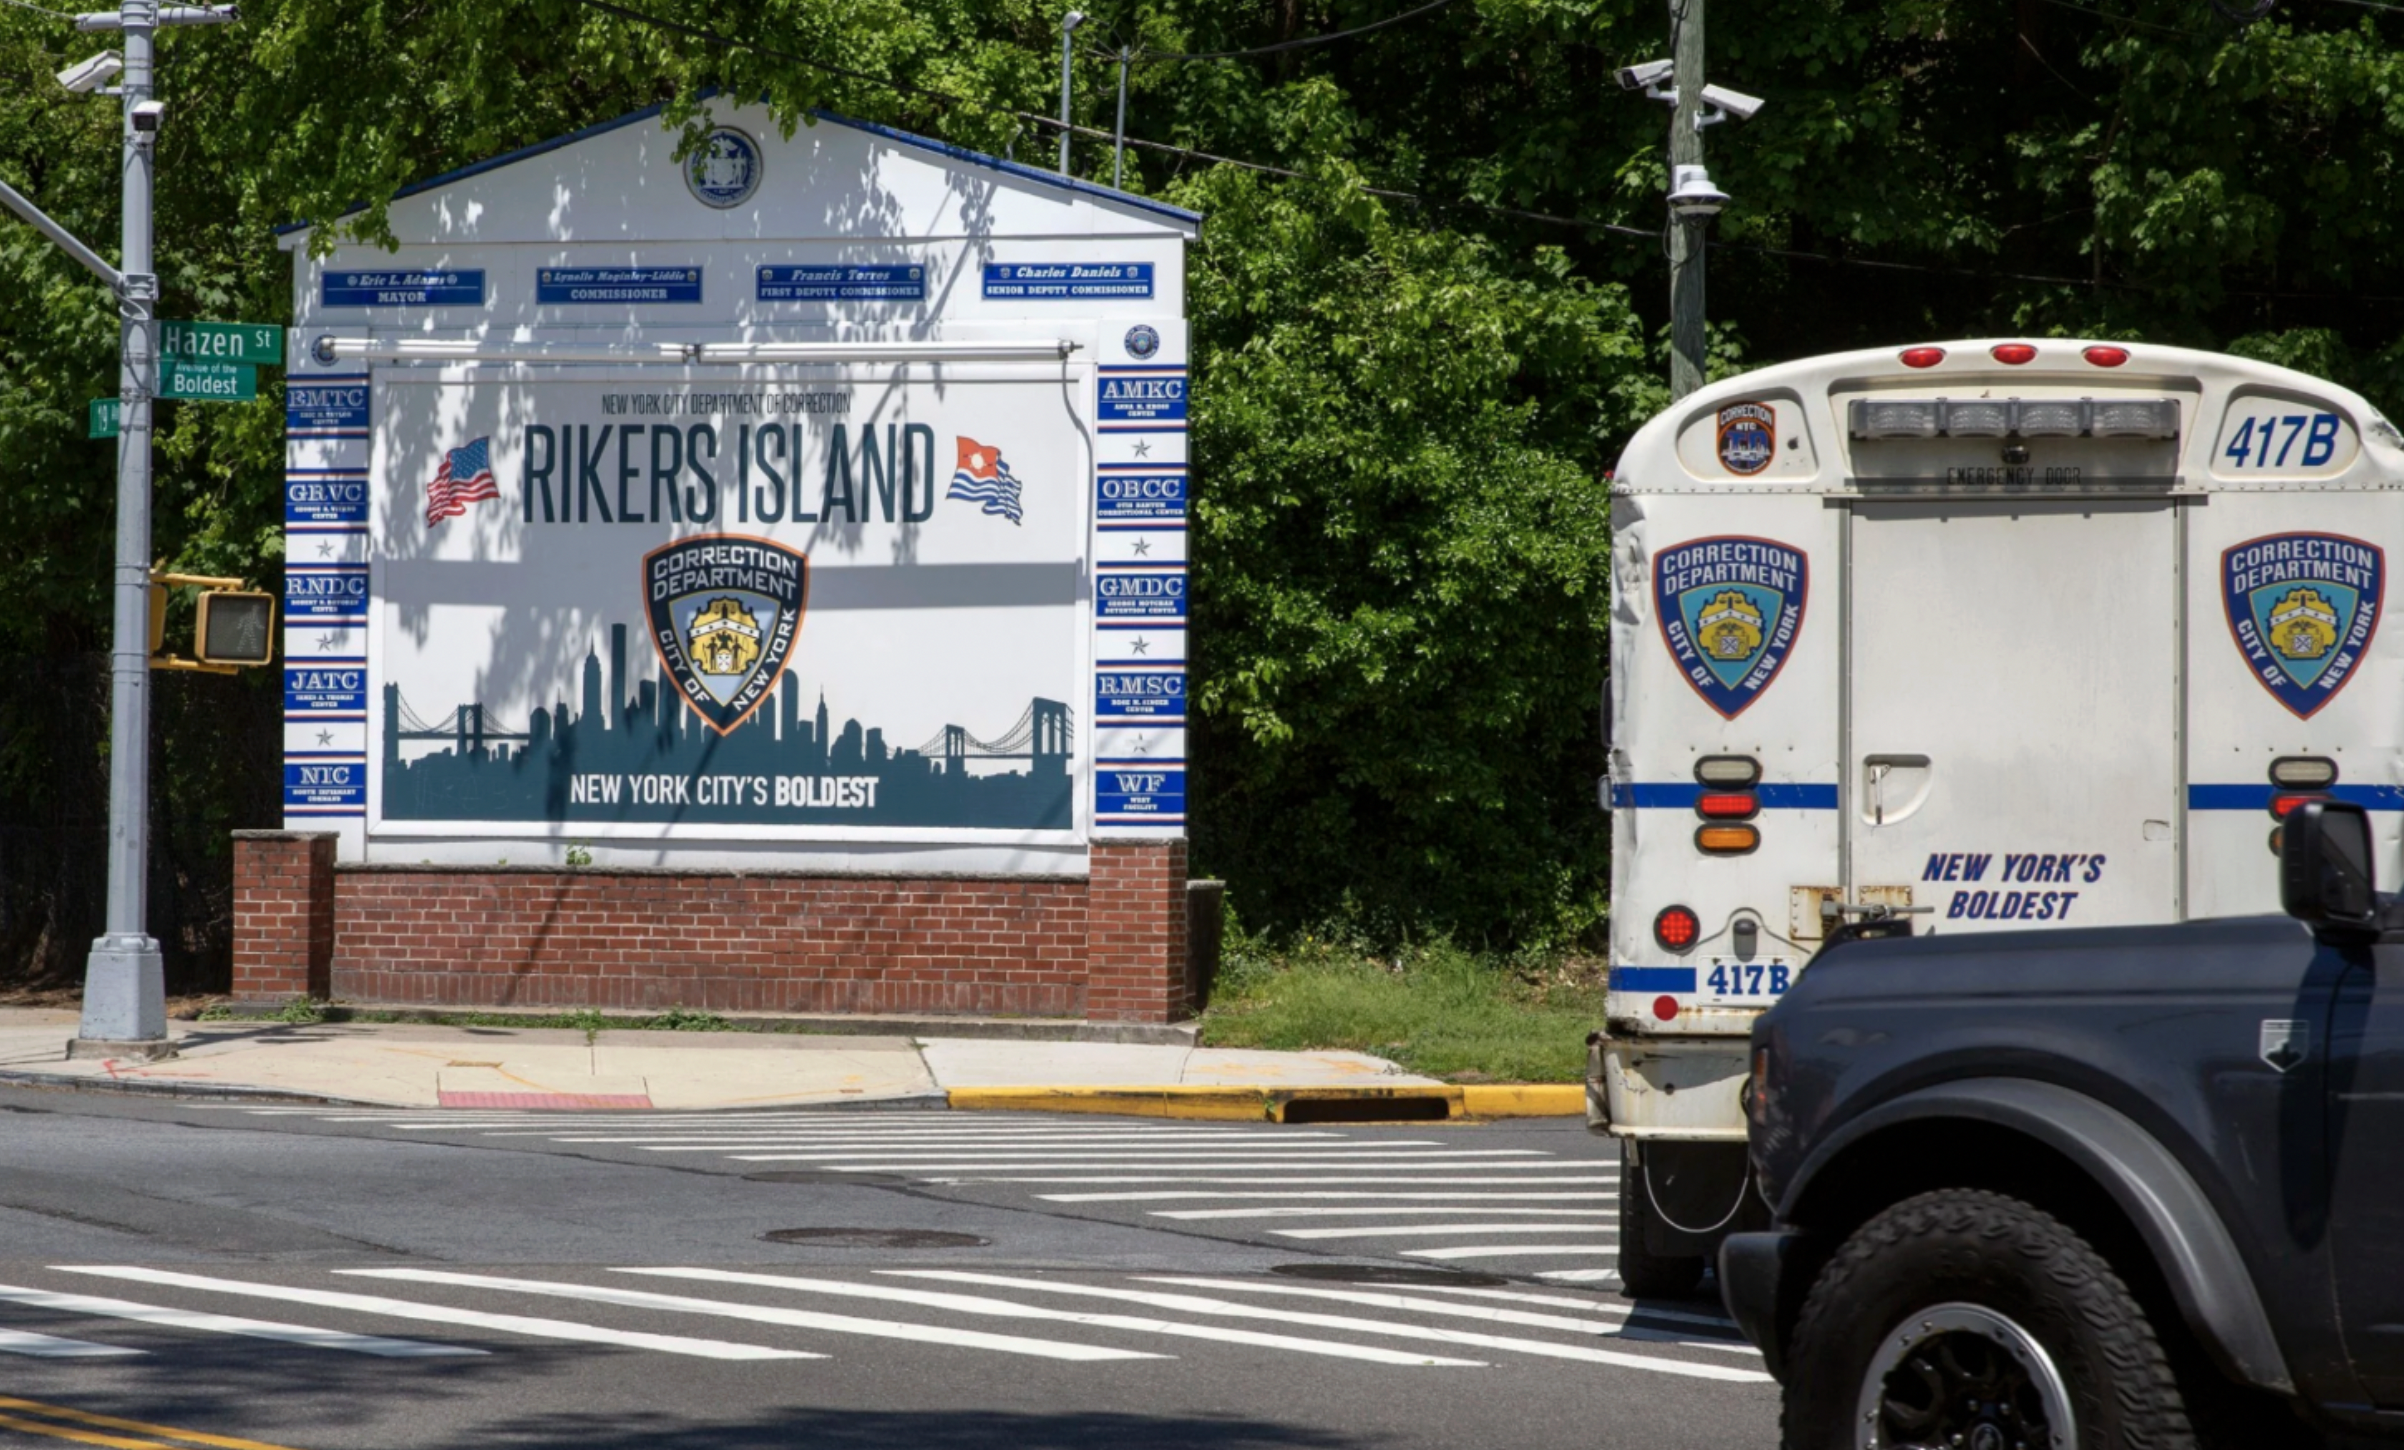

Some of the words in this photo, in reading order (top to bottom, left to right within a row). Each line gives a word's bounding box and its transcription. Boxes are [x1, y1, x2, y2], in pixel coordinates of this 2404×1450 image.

[359, 275, 386, 286] Eric
[388, 275, 400, 286] L.
[402, 274, 446, 286] Adams
[791, 269, 842, 281] Francis
[848, 269, 891, 281] Torres
[1016, 267, 1066, 278] Charles
[1070, 267, 1122, 278] Daniels
[378, 292, 426, 303] MAYOR
[570, 288, 668, 300] COMMISSIONER
[761, 287, 793, 297] FIRST
[795, 287, 837, 297] DEPUTY
[840, 286, 921, 296] COMMISSIONER
[986, 286, 1025, 295] SENIOR
[1028, 286, 1068, 295] DEPUTY
[1071, 285, 1149, 295] COMMISSIONER
[166, 326, 244, 357] Hazen
[255, 330, 272, 348] St
[211, 361, 220, 374] of
[222, 363, 237, 374] the
[174, 373, 238, 396] Boldest
[1102, 380, 1182, 399] AMKC
[288, 389, 364, 408] EMTC
[602, 393, 629, 415] NEW
[631, 393, 661, 415] YORK
[663, 393, 690, 415] CITY
[691, 392, 765, 415] DEPARTMENT
[766, 393, 782, 414] OF
[783, 392, 851, 414] CORRECTION
[1720, 404, 1772, 426] CORRECTION
[2225, 413, 2341, 468] 417B
[523, 422, 717, 524] RIKERS
[738, 422, 935, 524] ISLAND
[1947, 467, 2034, 485] EMERGENCY
[2045, 467, 2081, 485] DOOR
[288, 484, 362, 502] GRVC
[1102, 479, 1180, 498] OBCC
[654, 546, 797, 580] CORRECTION
[1663, 543, 1797, 575] CORRECTION
[2231, 539, 2373, 573] CORRECTION
[285, 577, 365, 595] RNDC
[653, 567, 796, 601] DEPARTMENT
[1099, 577, 1183, 597] GMDC
[1664, 563, 1796, 596] DEPARTMENT
[2234, 559, 2373, 595] DEPARTMENT
[1667, 620, 1696, 662] CITY
[1691, 665, 1715, 688] OF
[1743, 653, 1778, 691] NEW
[1772, 602, 1800, 649] YORK
[2237, 619, 2267, 661] CITY
[2263, 665, 2288, 688] OF
[2318, 652, 2354, 689] NEW
[2346, 600, 2376, 648] YORK
[659, 629, 688, 672] CITY
[684, 677, 710, 703] OF
[732, 669, 770, 711] NEW
[765, 608, 796, 664] YORK
[291, 672, 358, 690] JATC
[1099, 676, 1182, 695] RMSC
[300, 766, 350, 785] NIC
[1115, 773, 1166, 793] WF
[570, 774, 622, 803] NEW
[628, 774, 690, 804] YORK
[697, 775, 768, 805] CITY'S
[775, 776, 879, 807] BOLDEST
[1921, 853, 1993, 882] NEW
[2001, 853, 2107, 883] YORK'S
[1946, 890, 2079, 920] BOLDEST
[1706, 965, 1791, 995] 417B
